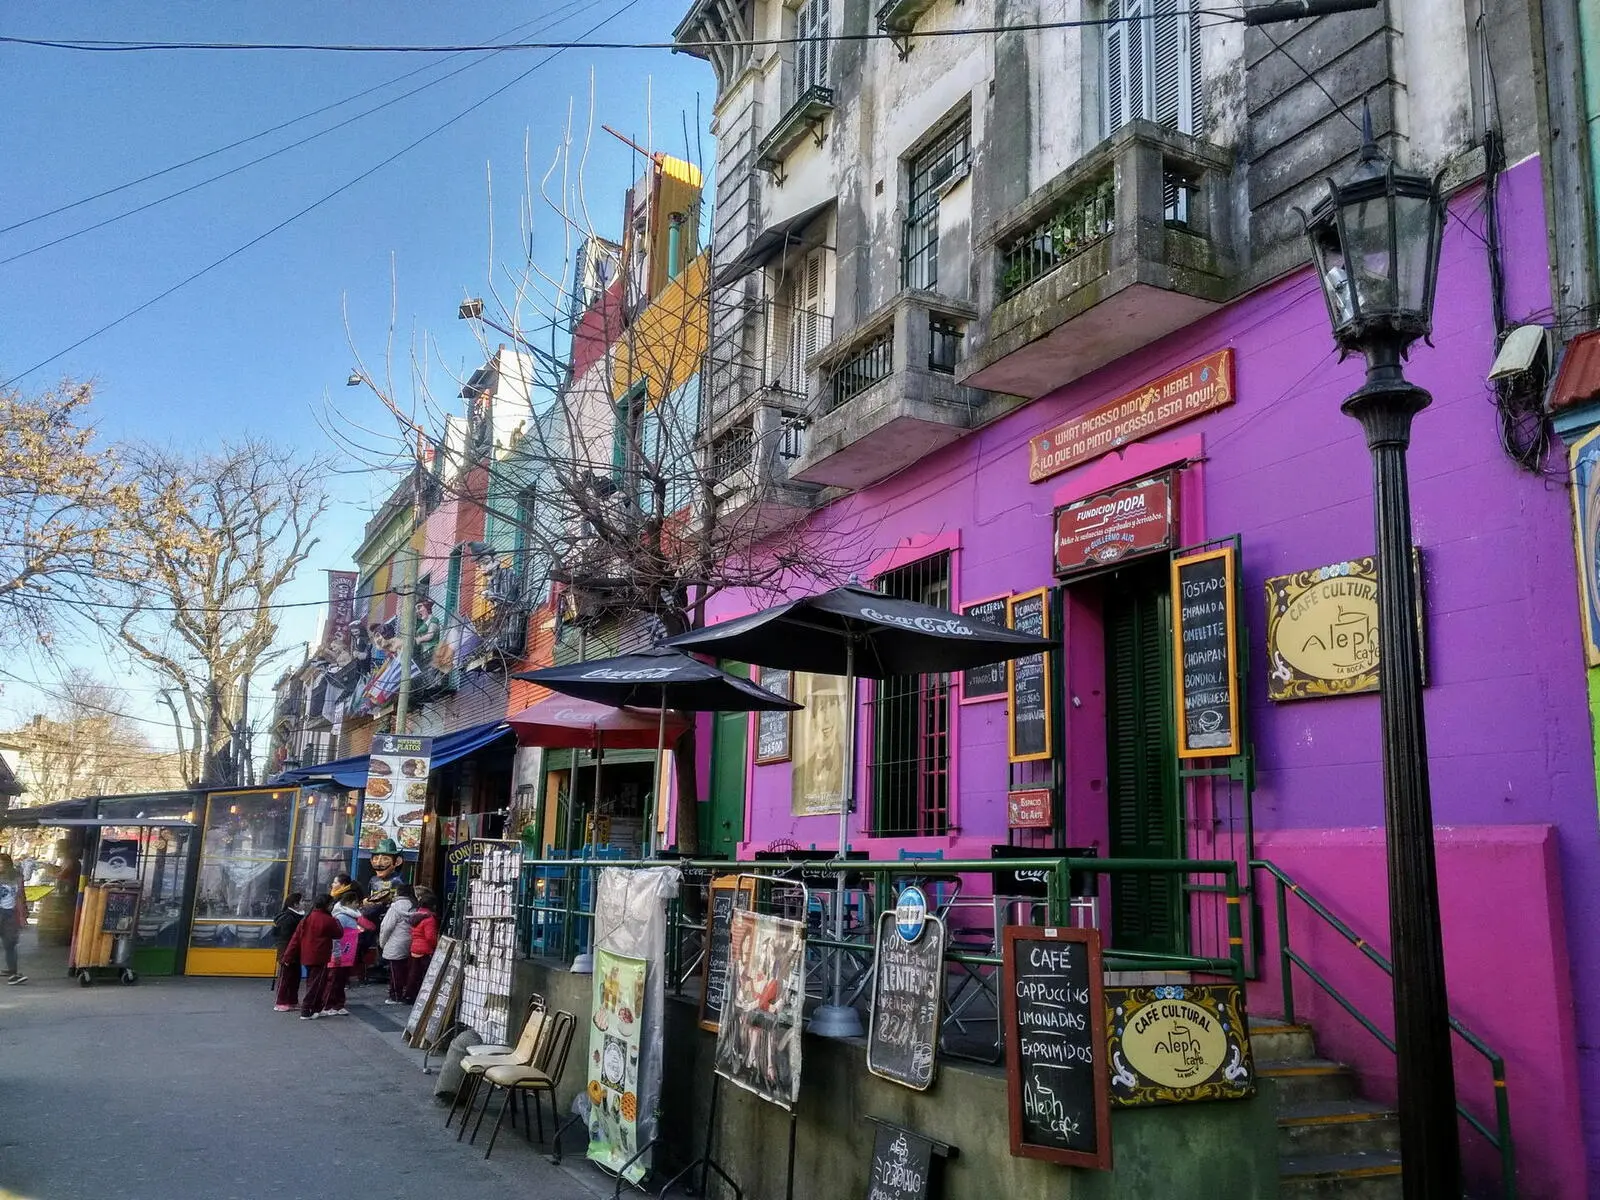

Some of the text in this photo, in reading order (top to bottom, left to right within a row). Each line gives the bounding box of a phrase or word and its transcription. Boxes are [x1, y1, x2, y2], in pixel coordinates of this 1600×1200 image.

[1055, 424, 1079, 446] WHAT
[1082, 407, 1120, 434] PICASSO
[1163, 372, 1194, 398] HERE!
[1054, 447, 1072, 465] QUE
[1072, 440, 1085, 456] NO
[1087, 430, 1112, 452] PINTO
[1157, 400, 1183, 420] ESTA
[1185, 383, 1214, 408] AQUI!
[1076, 493, 1145, 521] FUNDICION POPA
[1181, 576, 1227, 598] TOSTADO
[1322, 582, 1378, 603] CULTURA
[860, 608, 974, 636] Coca-Cola
[1182, 601, 1225, 621] EMPANADA
[1185, 671, 1225, 689] BONDIOLA
[397, 743, 421, 751] PLATOS
[1030, 945, 1072, 971] CAFÉ
[1018, 1010, 1086, 1031] LIMONADAS
[1134, 1004, 1211, 1034] CAFÉ CULTURAL
[1154, 1030, 1201, 1065] Aleph
[1024, 1079, 1064, 1122] Aleph
